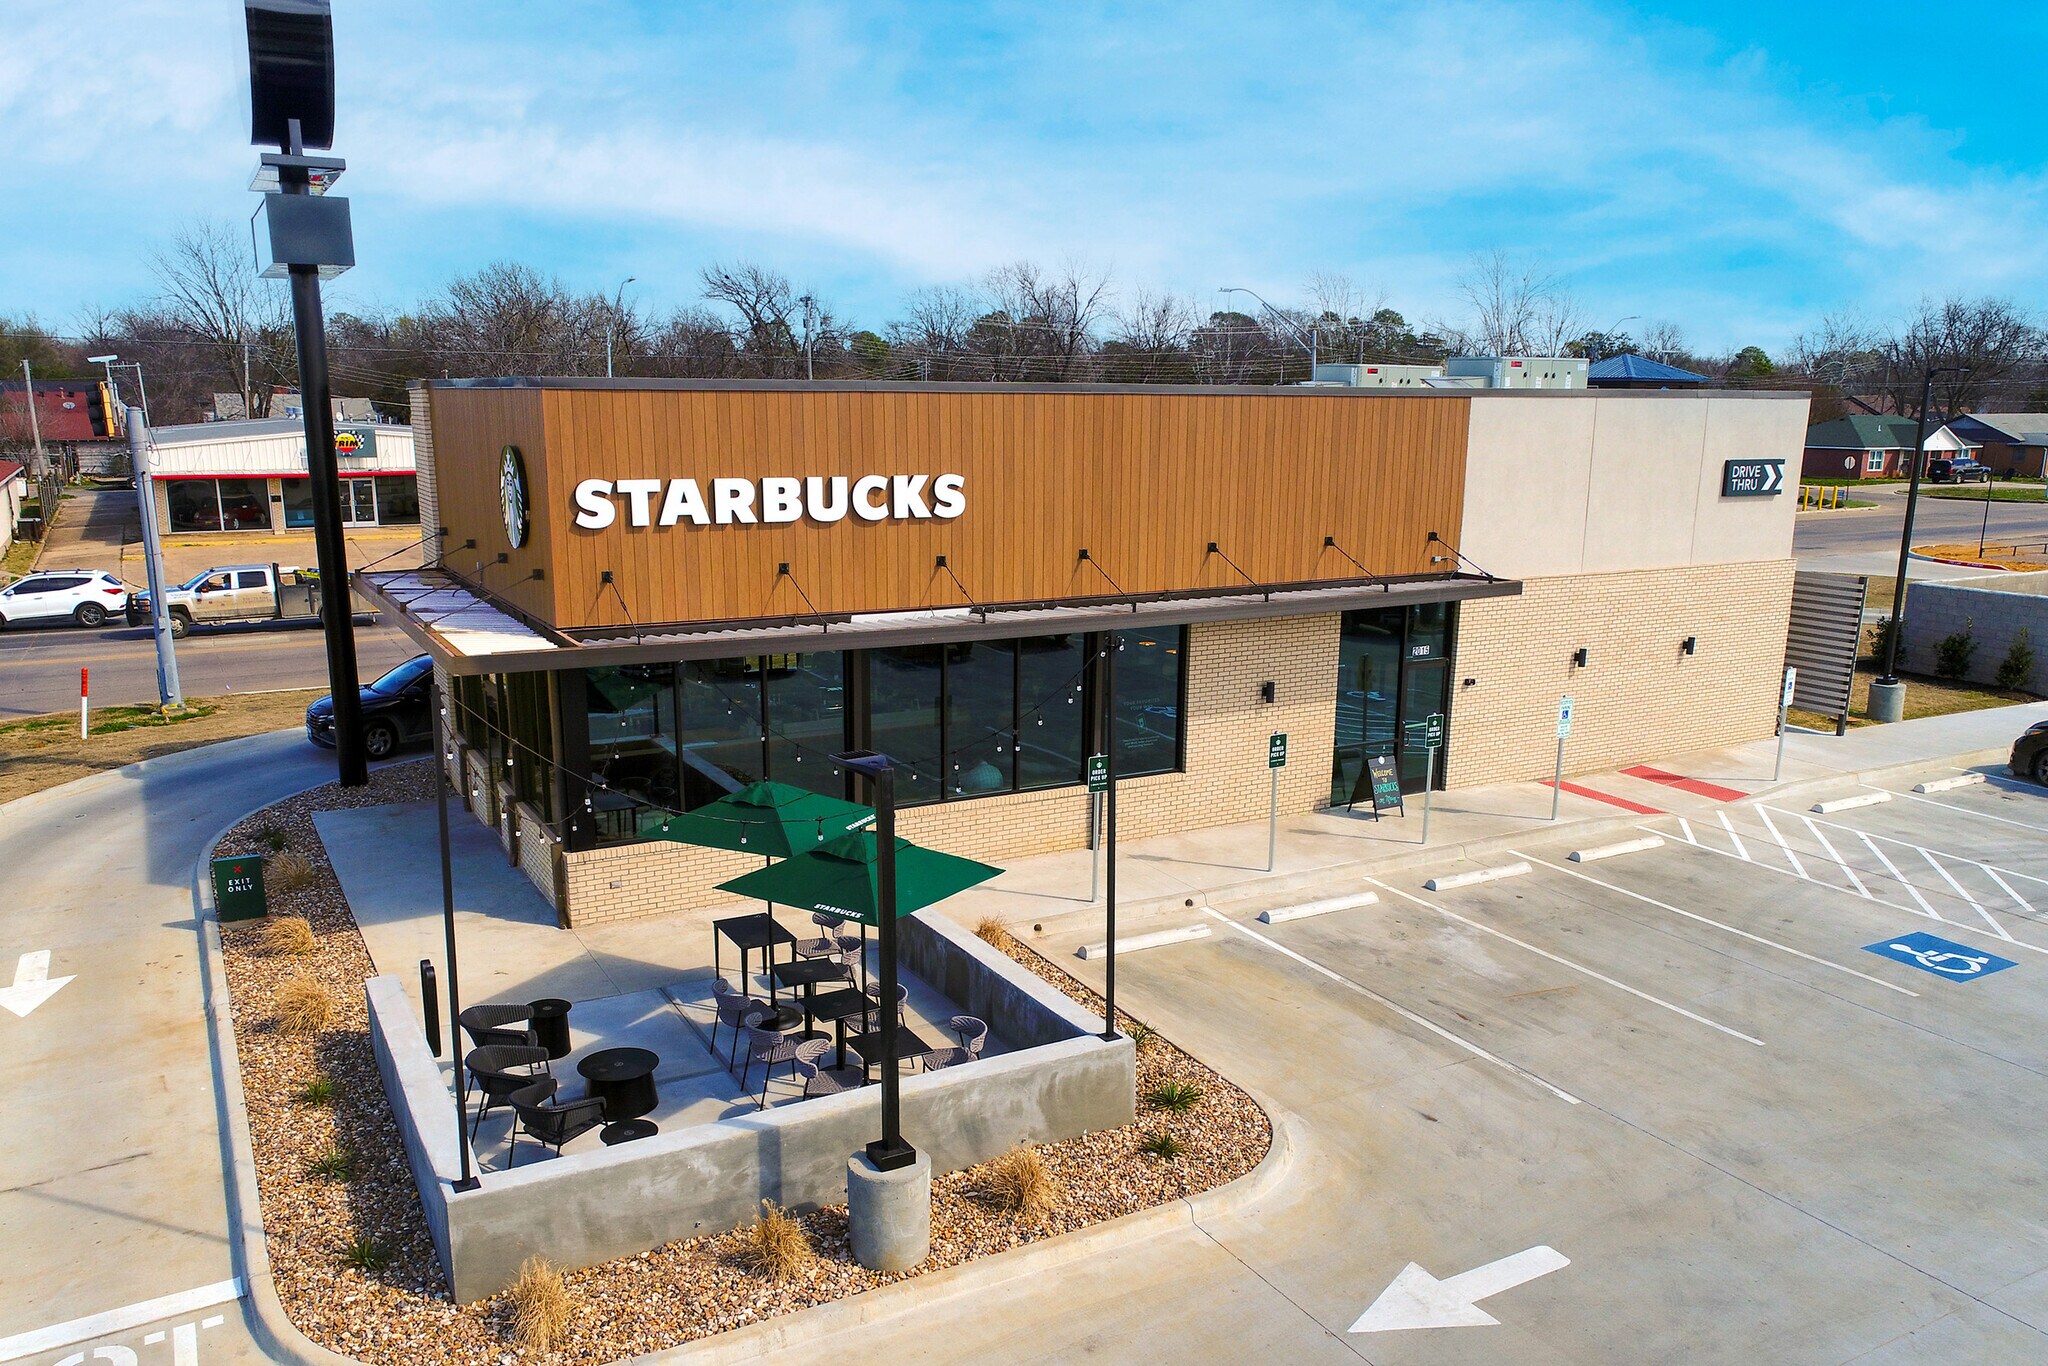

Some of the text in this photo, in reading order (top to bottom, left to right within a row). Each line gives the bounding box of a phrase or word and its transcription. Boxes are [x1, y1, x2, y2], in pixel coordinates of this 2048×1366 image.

[1732, 465, 1761, 478] DRIVE
[1731, 478, 1758, 491] THRU
[574, 473, 967, 530] STARBUCKS
[1412, 645, 1430, 656] 2015
[228, 877, 251, 886] EXIT
[227, 884, 253, 893] ONLY
[813, 903, 863, 919] STARBUCKS
